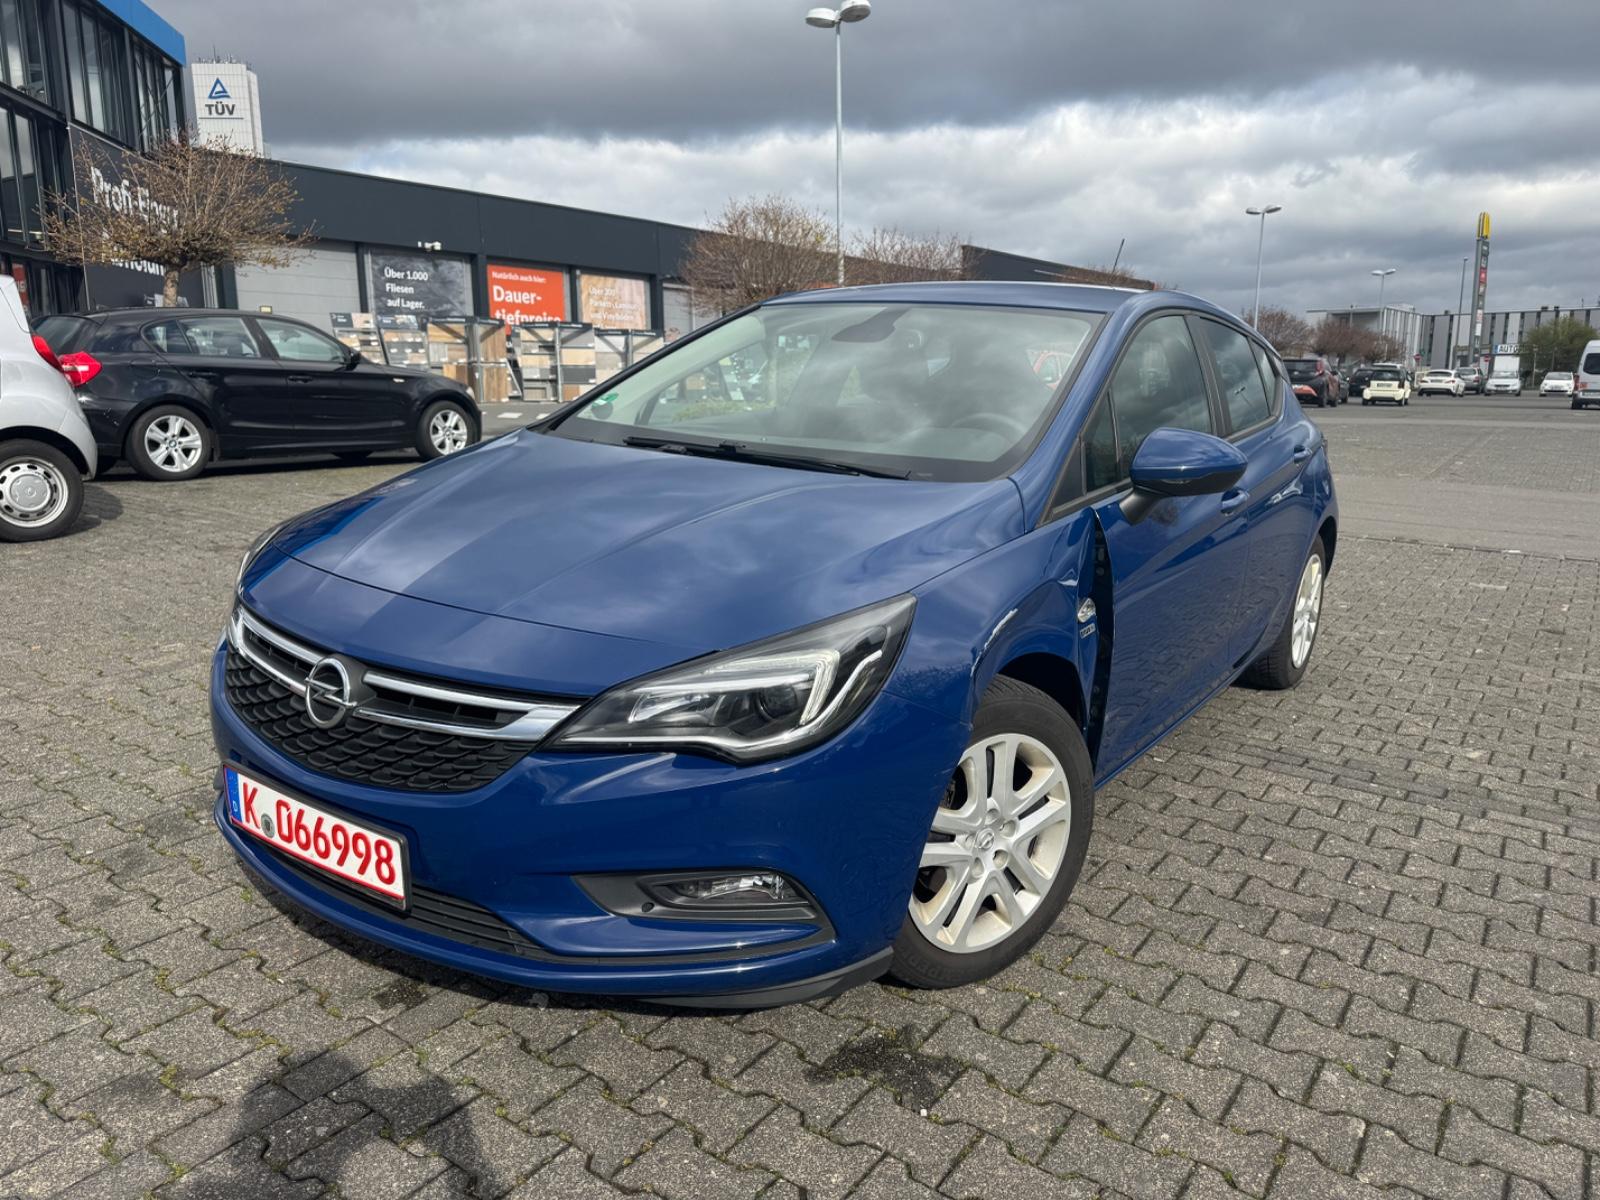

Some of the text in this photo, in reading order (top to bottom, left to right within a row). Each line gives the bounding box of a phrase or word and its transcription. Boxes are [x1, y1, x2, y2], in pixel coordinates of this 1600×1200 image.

[204, 101, 236, 116] TÜV
[384, 266, 429, 281] Über 1.000
[385, 282, 414, 294] Fliesen
[492, 285, 542, 304] Dauer-
[386, 297, 425, 310] auf Lager.
[243, 782, 396, 885] K 066998
